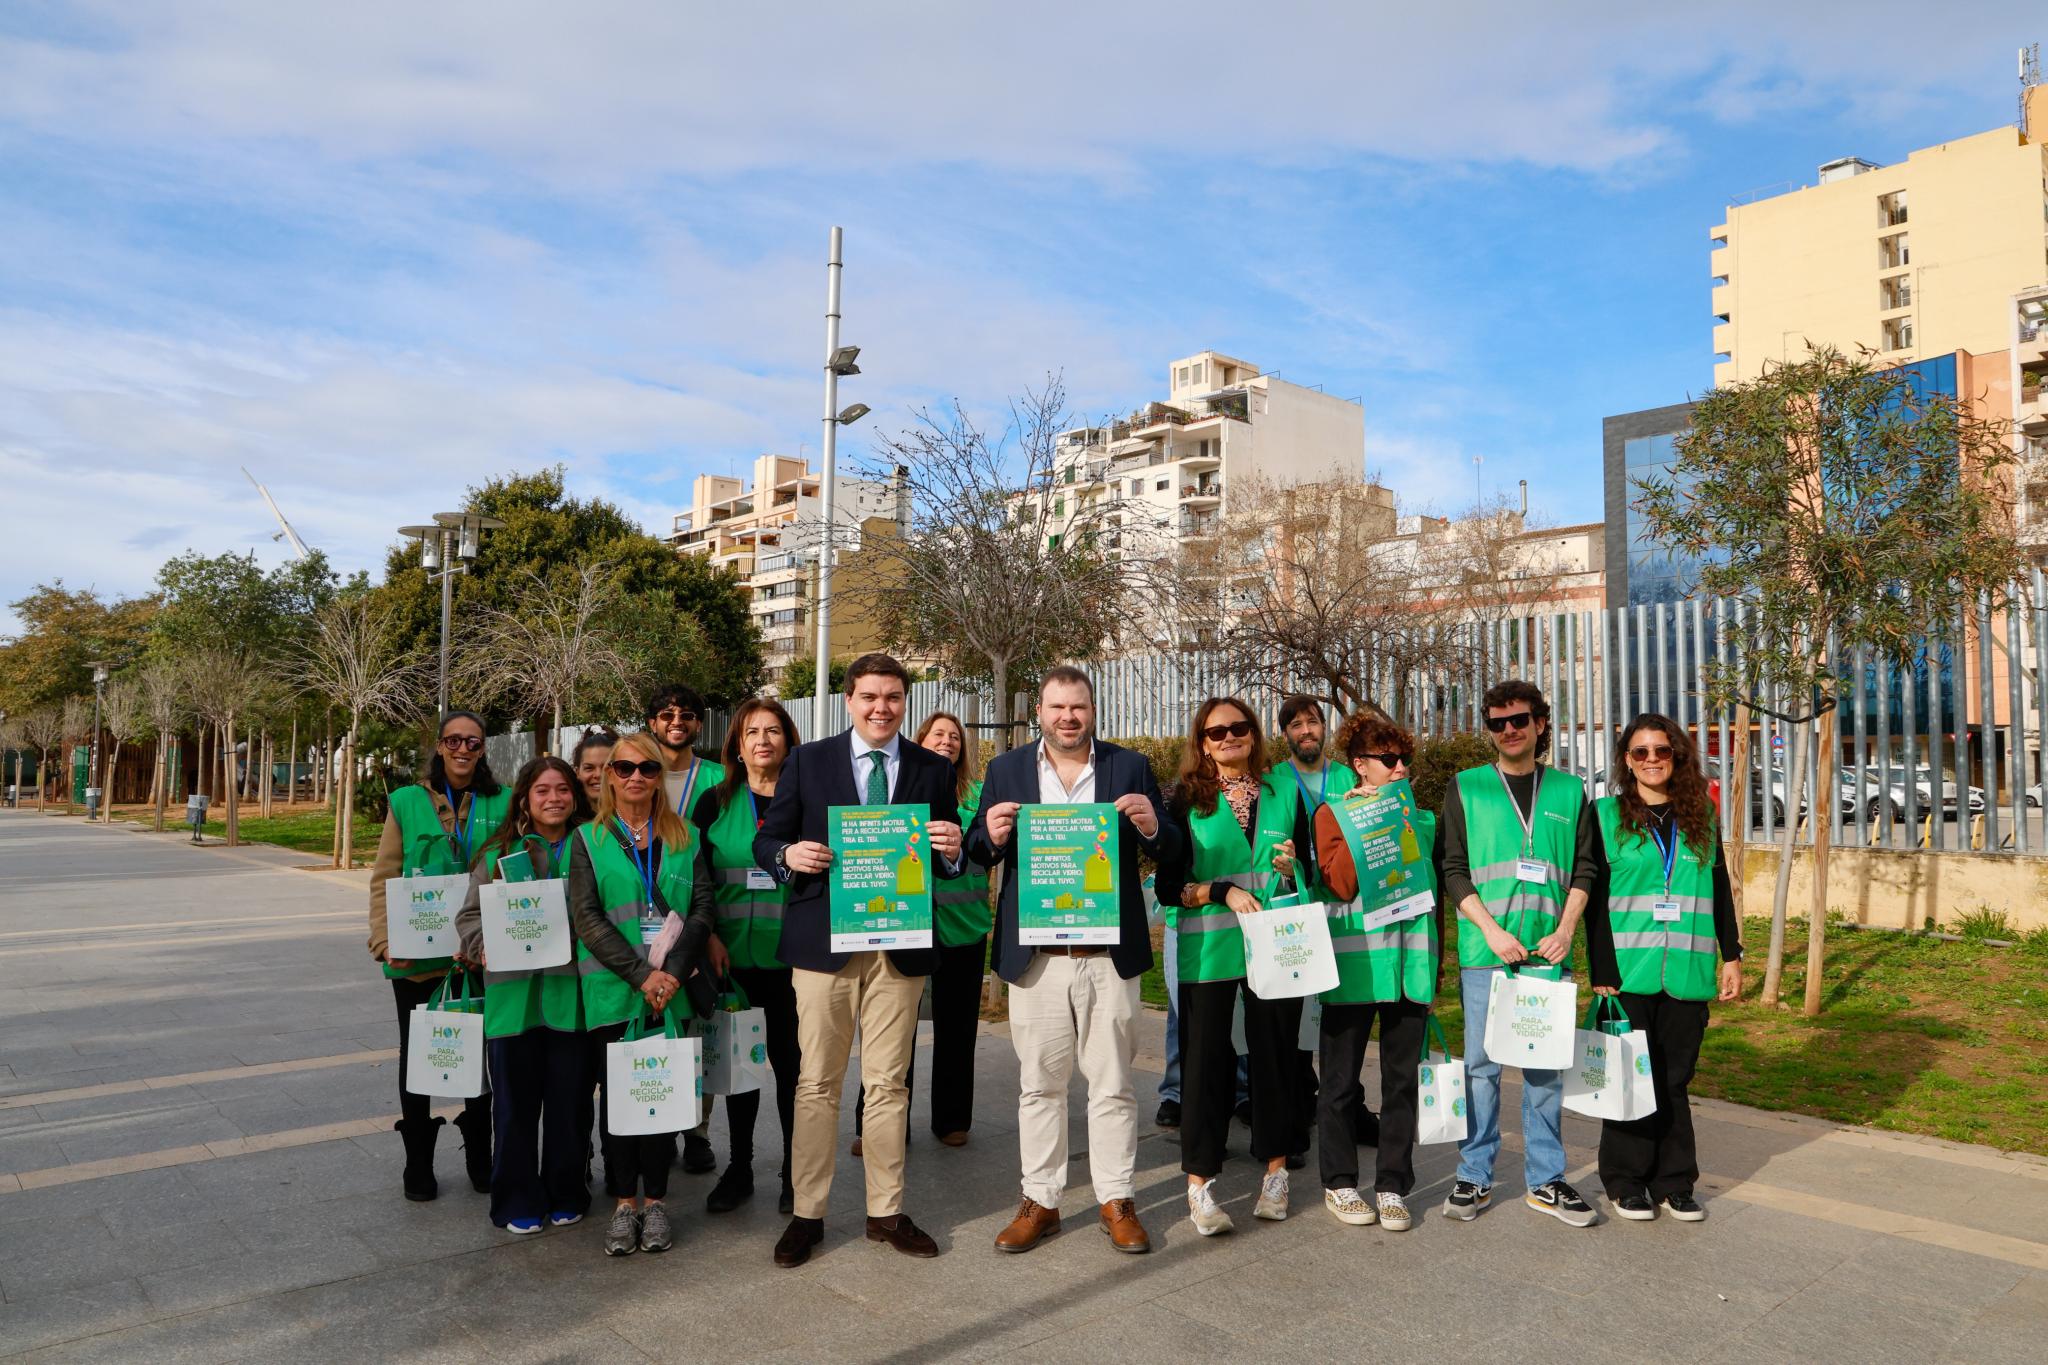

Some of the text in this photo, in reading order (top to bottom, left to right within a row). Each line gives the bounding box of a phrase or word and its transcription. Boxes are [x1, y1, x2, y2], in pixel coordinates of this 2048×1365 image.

[412, 890, 444, 902] HOY
[508, 897, 541, 910] HOY
[409, 917, 449, 925] RECICLAR
[415, 923, 442, 931] VIDRIO
[506, 925, 548, 934] RECICLAR
[1274, 922, 1304, 937] HOY
[512, 932, 541, 940] VIDRIO
[1274, 950, 1312, 961] RECICLAR
[1280, 958, 1307, 967] VIDRIO
[1516, 995, 1549, 1007] HOY
[433, 1026, 461, 1038] HOY
[1512, 1023, 1552, 1032] RECICLAR
[1516, 1029, 1544, 1038] VIDRIO
[634, 1056, 668, 1070] HOY
[631, 1086, 673, 1096] RECICLAR
